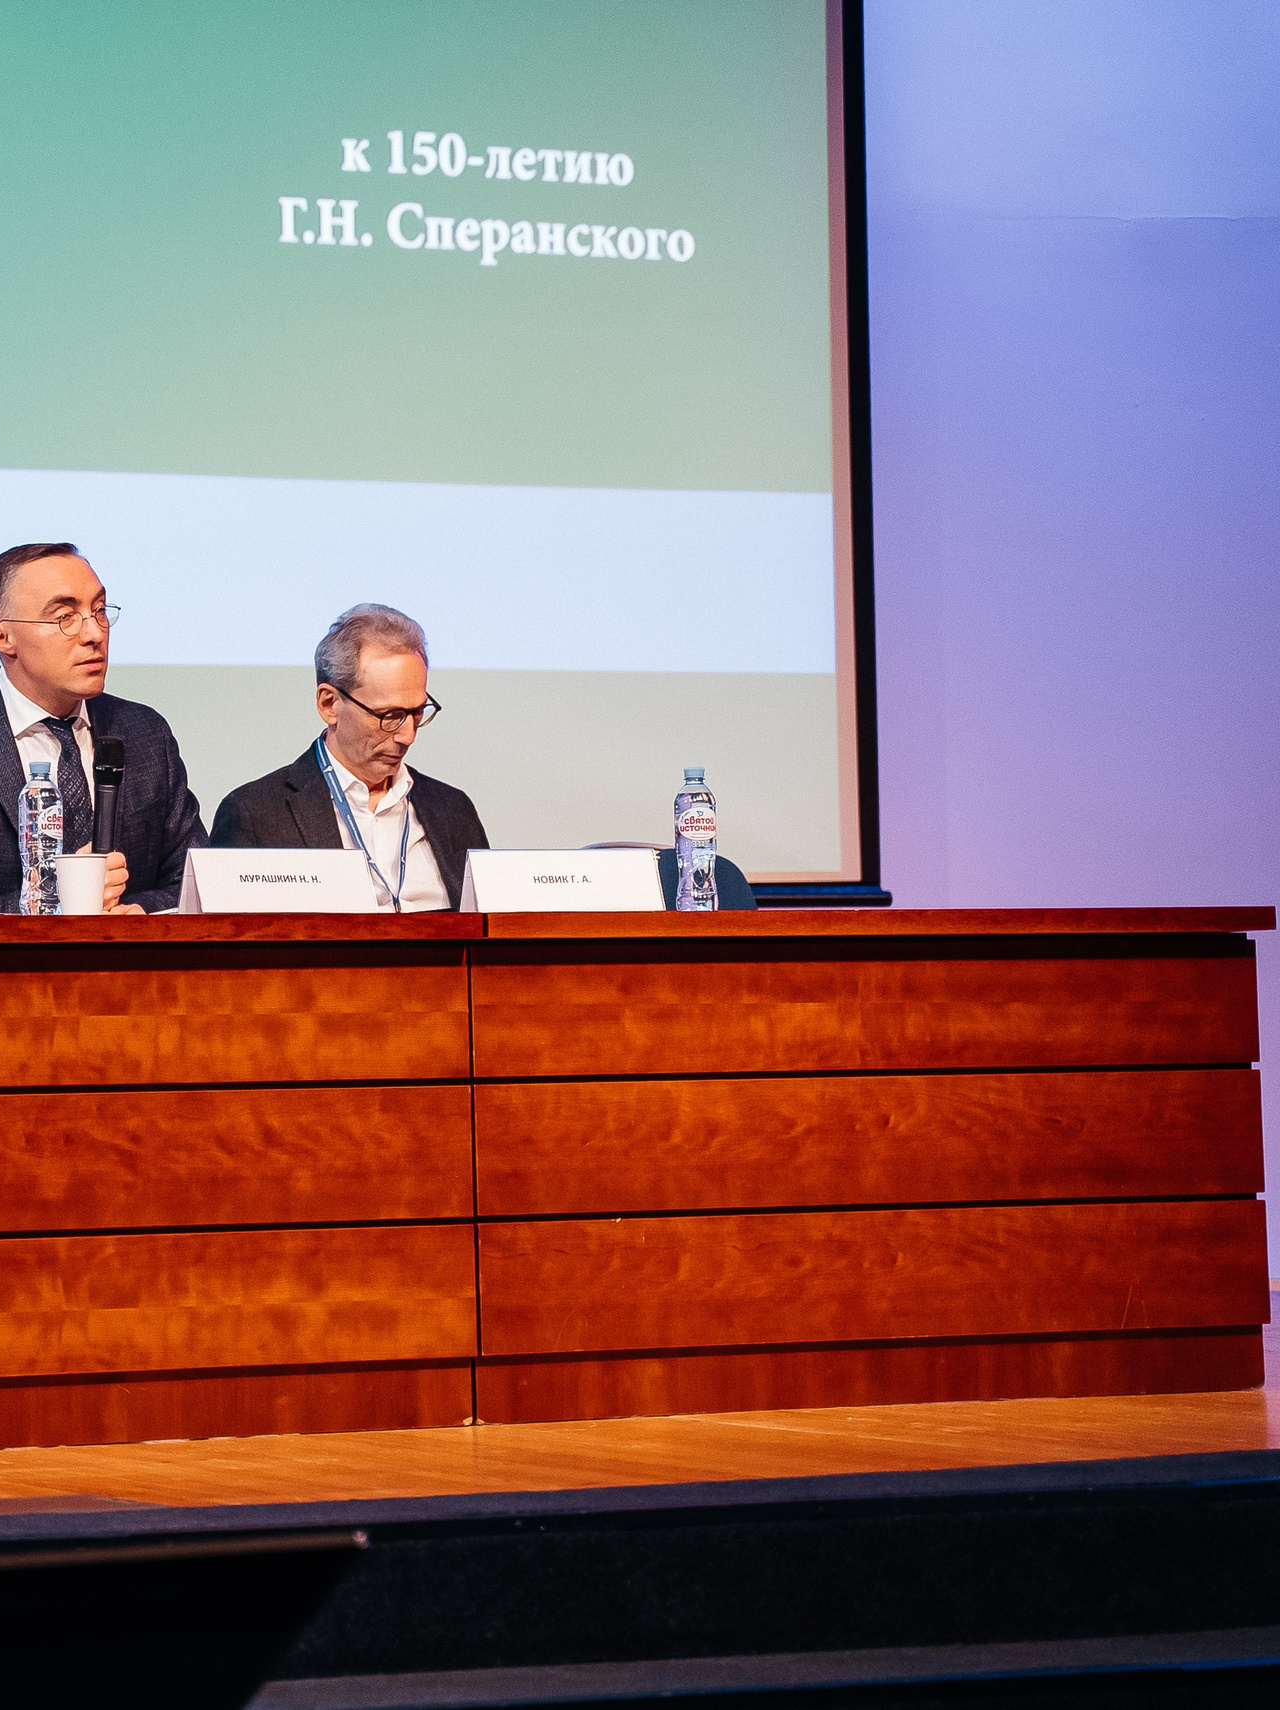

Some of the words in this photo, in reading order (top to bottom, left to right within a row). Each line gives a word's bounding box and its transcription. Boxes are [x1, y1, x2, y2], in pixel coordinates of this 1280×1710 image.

[340, 137, 372, 173] к
[386, 130, 635, 187] 150-летию
[278, 196, 374, 247] Г.Н.
[386, 201, 696, 267] Сперанского
[239, 874, 298, 884] МУРАШКИН
[299, 875, 310, 884] Н.
[311, 876, 322, 884] Н.
[533, 875, 569, 884] НОВИК
[570, 875, 580, 884] Г.
[581, 875, 592, 884] А.
